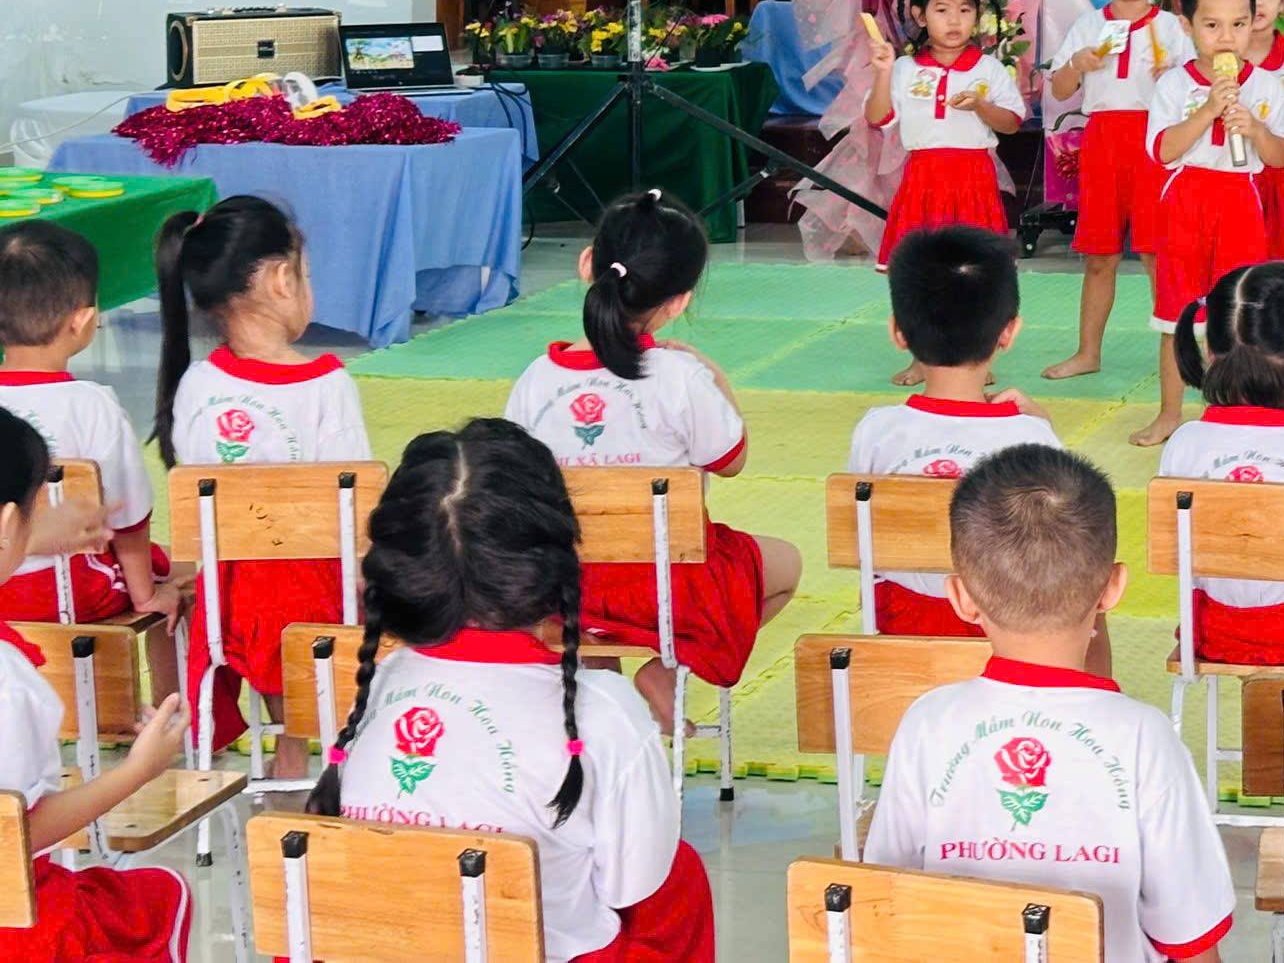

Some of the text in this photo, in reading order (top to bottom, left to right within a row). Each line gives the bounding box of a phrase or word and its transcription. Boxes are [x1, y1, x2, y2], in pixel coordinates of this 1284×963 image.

[1021, 709, 1064, 733] Non
[1068, 721, 1106, 757] Hoa
[1104, 755, 1133, 812] Hồng
[940, 836, 1121, 865] PHƯỜNG LAGI
